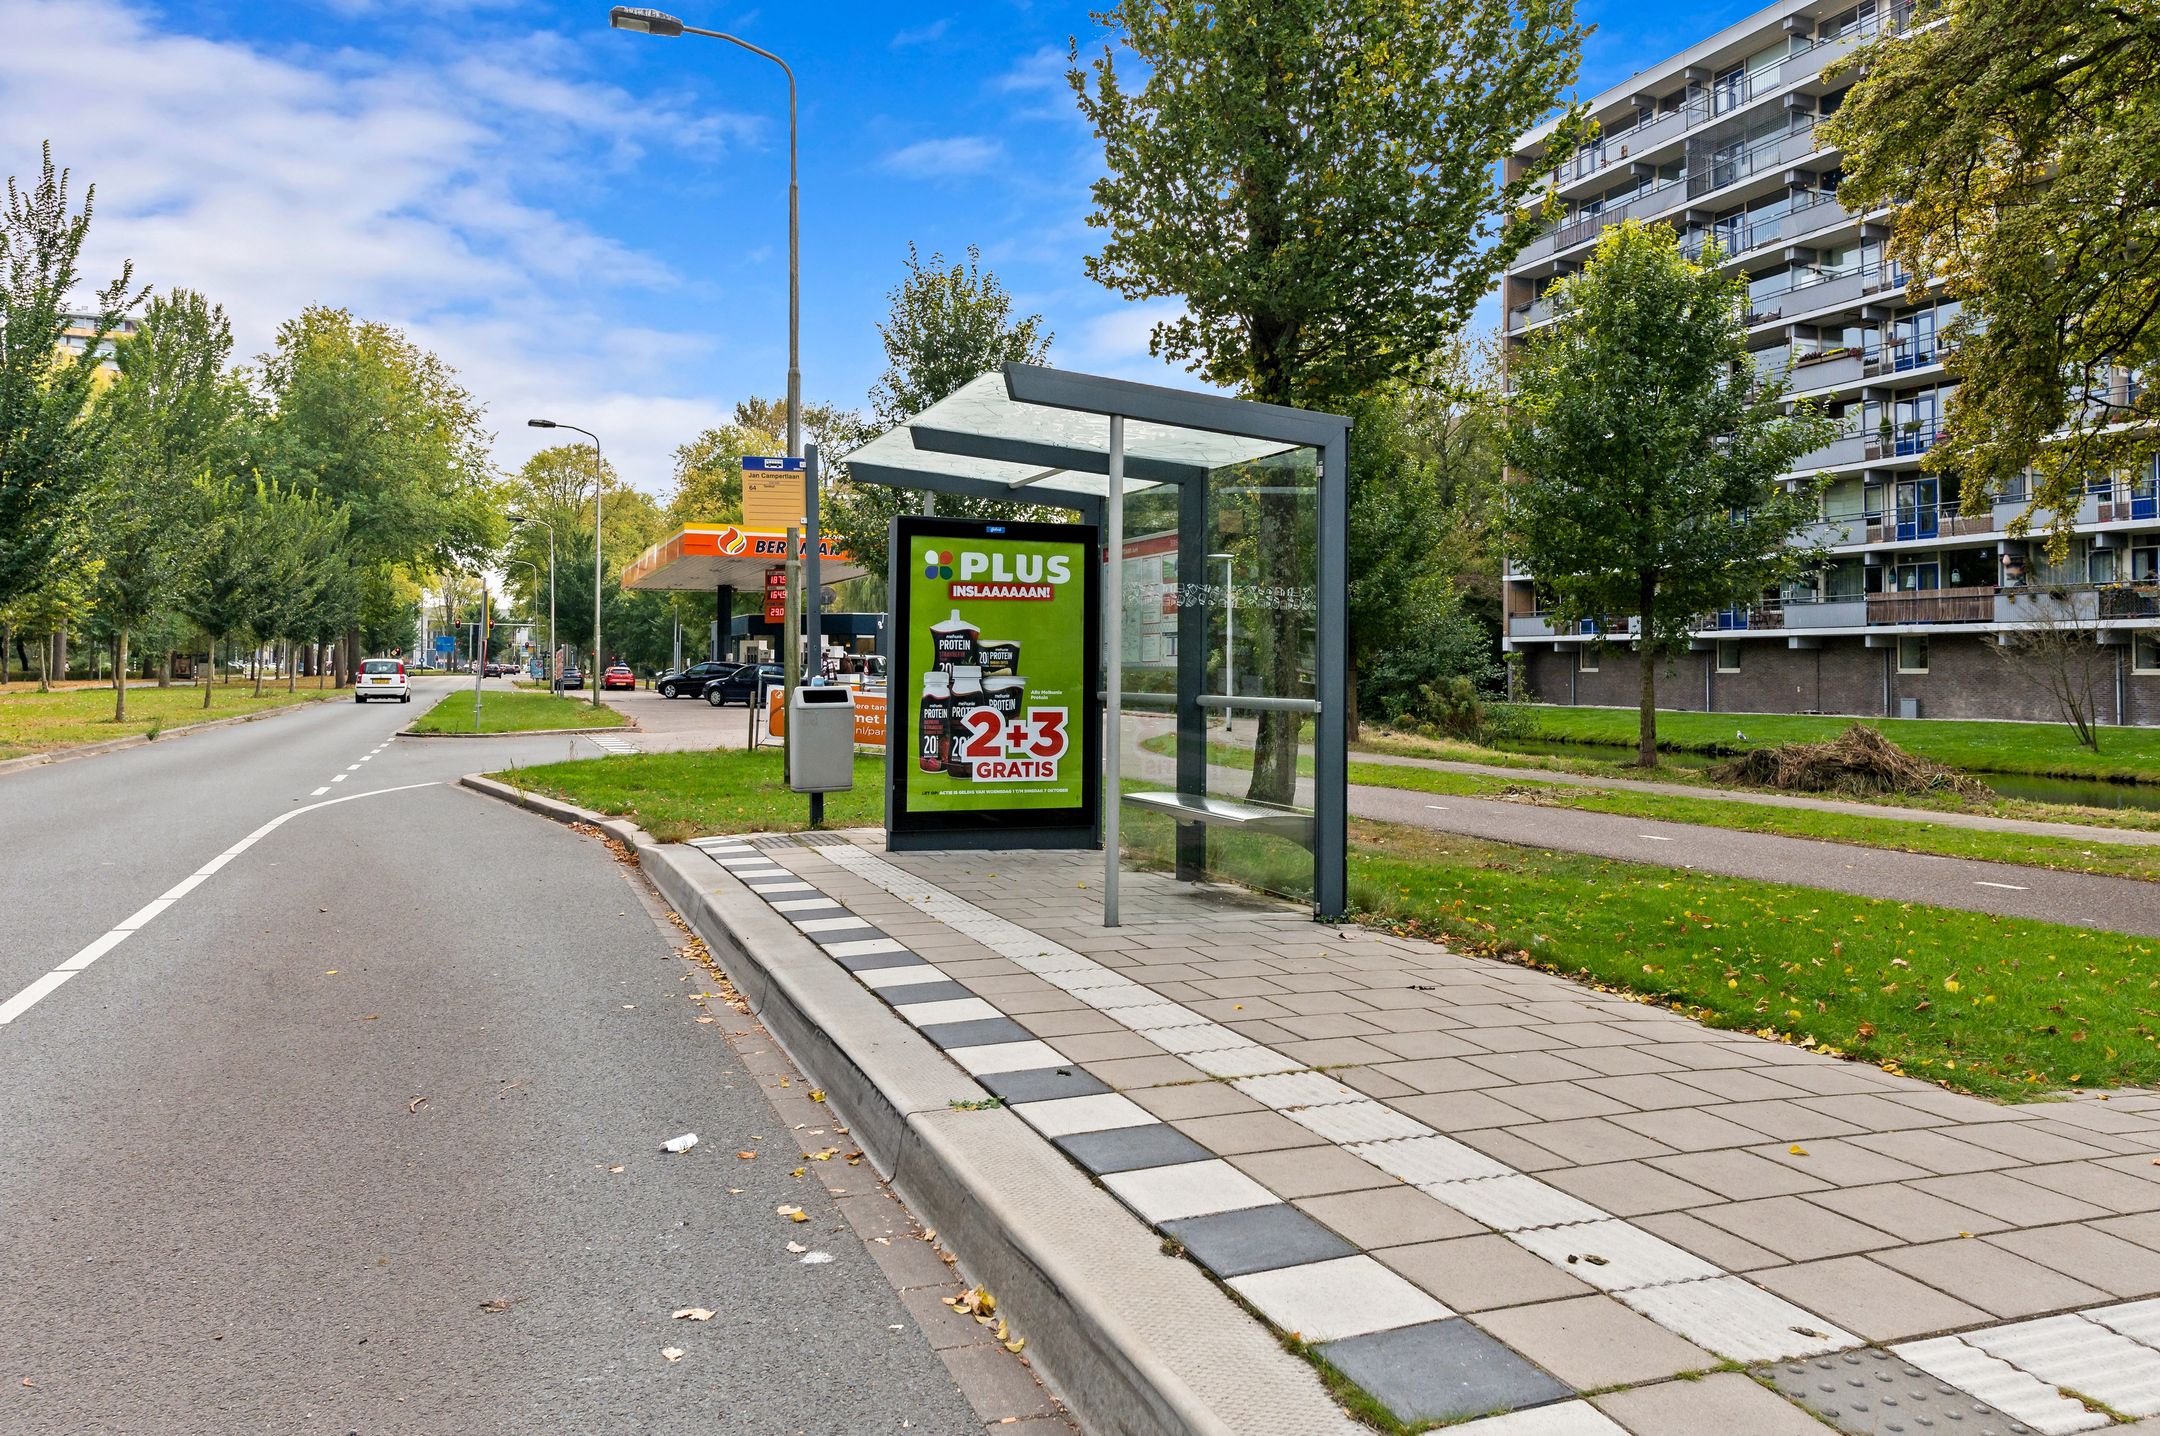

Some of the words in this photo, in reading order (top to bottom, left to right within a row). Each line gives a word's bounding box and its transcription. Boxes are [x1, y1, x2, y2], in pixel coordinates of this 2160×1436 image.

[761, 472, 800, 480] Campertlaan
[960, 552, 1071, 584] PLUS
[939, 639, 971, 651] PROTEIN
[989, 651, 1013, 660] PROTEIN
[923, 708, 948, 719] PROTEIN
[965, 710, 1065, 758] 2+3
[923, 735, 937, 755] 20
[976, 761, 1054, 779] GRATIS
